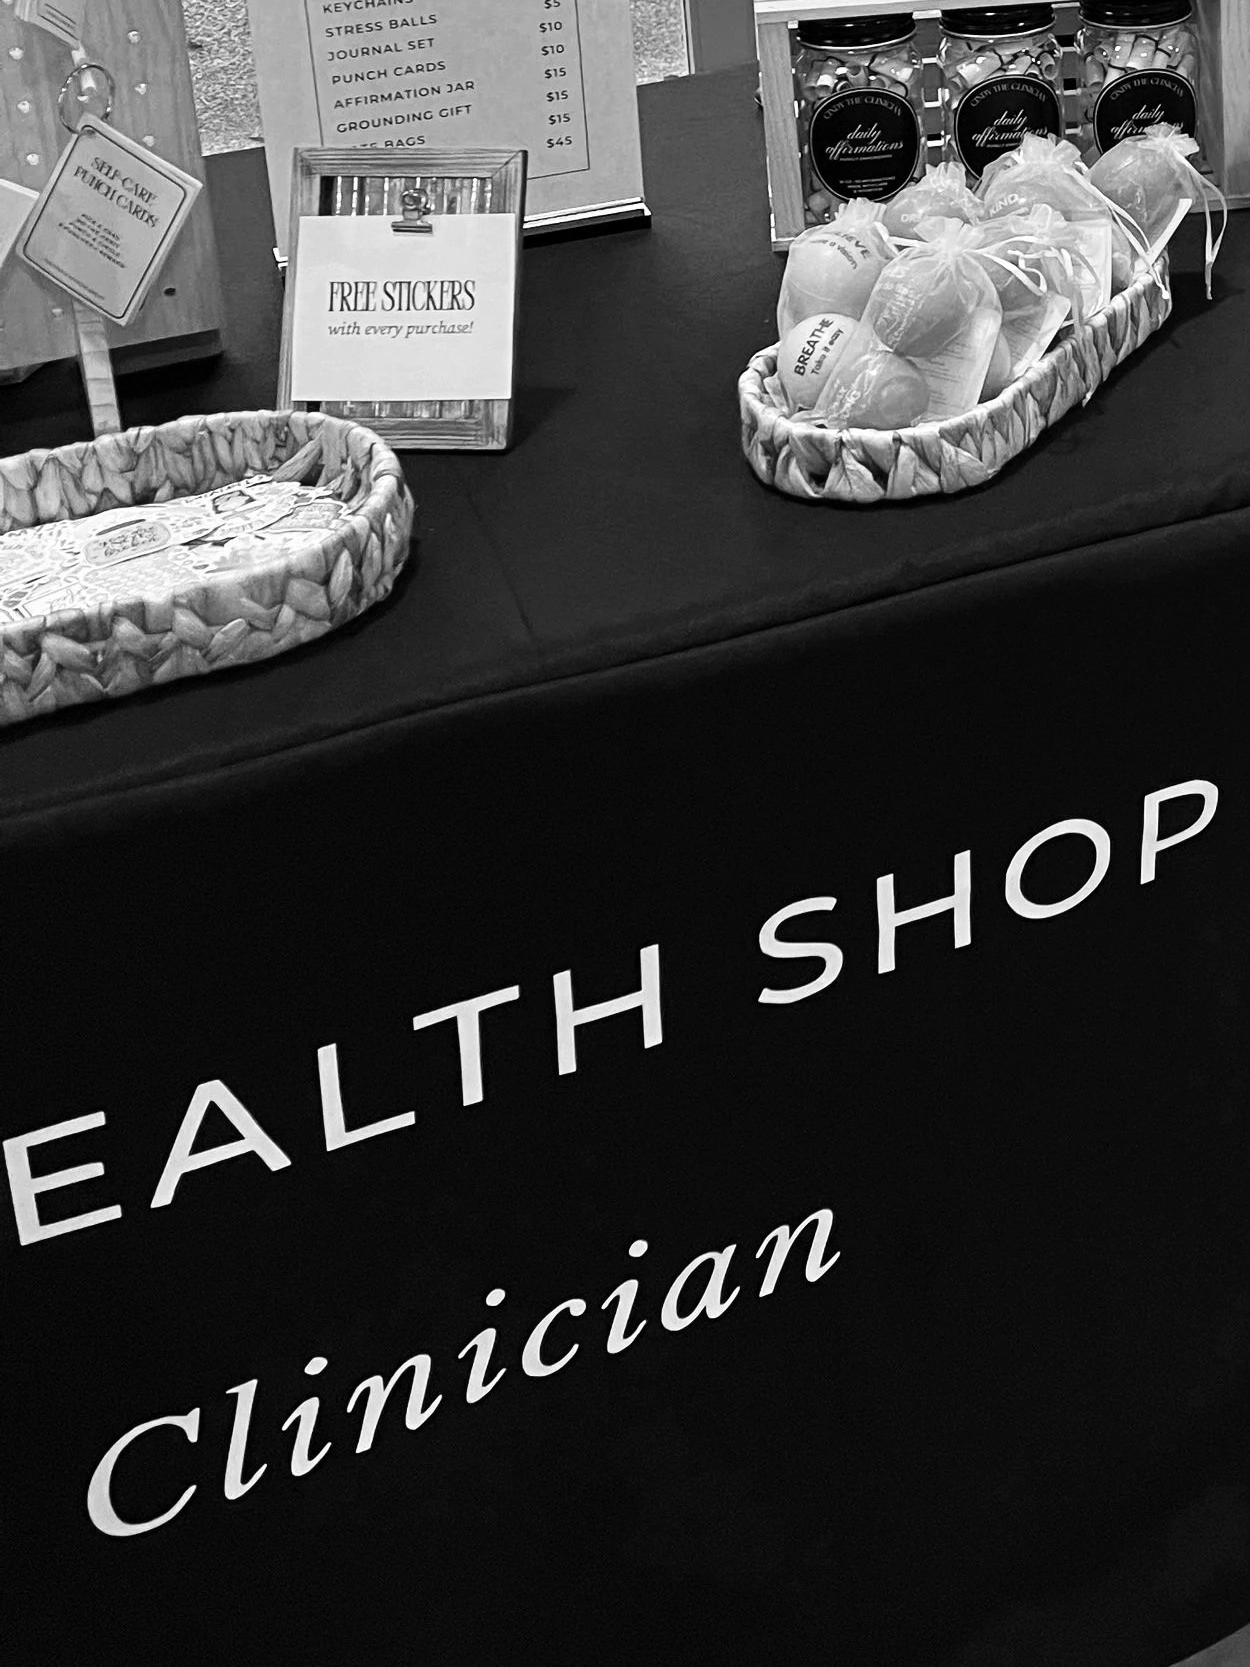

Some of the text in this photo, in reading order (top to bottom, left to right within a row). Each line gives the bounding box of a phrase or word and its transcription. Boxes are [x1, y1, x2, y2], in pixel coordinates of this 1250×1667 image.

[325, 20, 384, 38] STRESS
[389, 14, 438, 31] BALLS
[327, 21, 563, 62] JOURNAL SET $10
[331, 44, 565, 85] PUNCH CARDS $10
[333, 67, 568, 110] AFFIRMATION JAR $15
[336, 90, 569, 134] GROUNDING GIFT $15
[548, 113, 572, 126] $15
[993, 108, 1028, 132] daily
[1131, 103, 1165, 124] daily
[546, 136, 573, 149] $45
[825, 139, 904, 161] affirmations
[846, 122, 882, 145] daily
[73, 164, 162, 229] PUNCH CARDS
[89, 156, 159, 208] SELF-CARE
[327, 279, 476, 312] FREE STICKERS
[327, 320, 475, 339] with every purchase!
[793, 317, 835, 377] BREATHE
[810, 351, 828, 375] Take
[828, 328, 845, 347] easy
[2, 776, 1220, 1247] EALTH SHOP
[84, 1206, 843, 1538] Clinician
